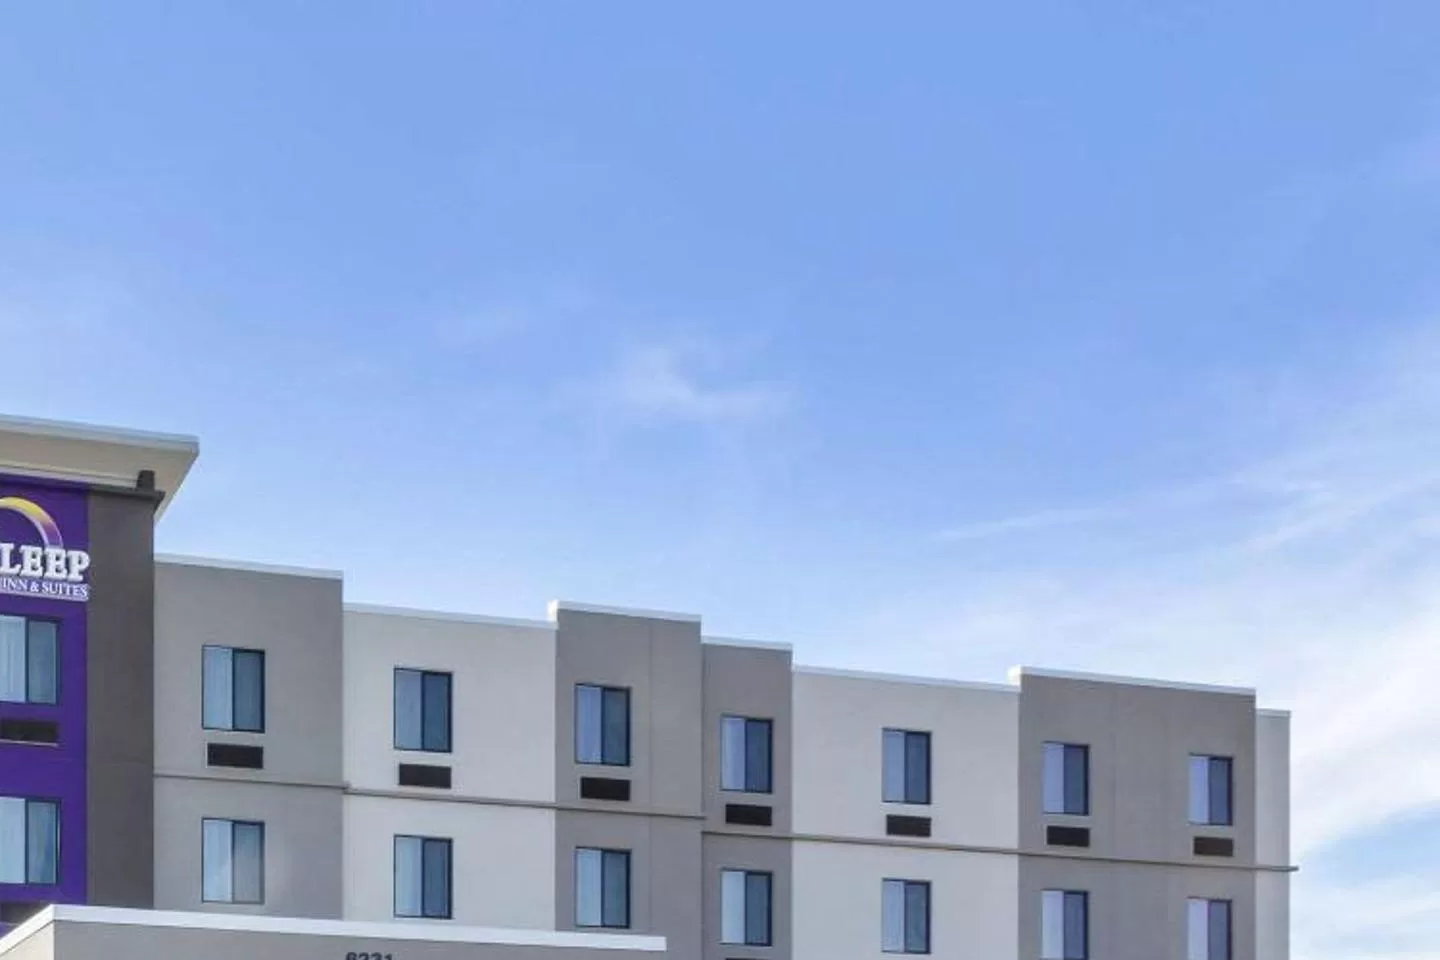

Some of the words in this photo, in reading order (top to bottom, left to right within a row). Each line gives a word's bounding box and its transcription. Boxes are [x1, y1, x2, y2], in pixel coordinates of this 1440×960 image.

[2, 577, 28, 590] INN
[30, 581, 39, 593] &
[41, 582, 88, 597] SUITES
